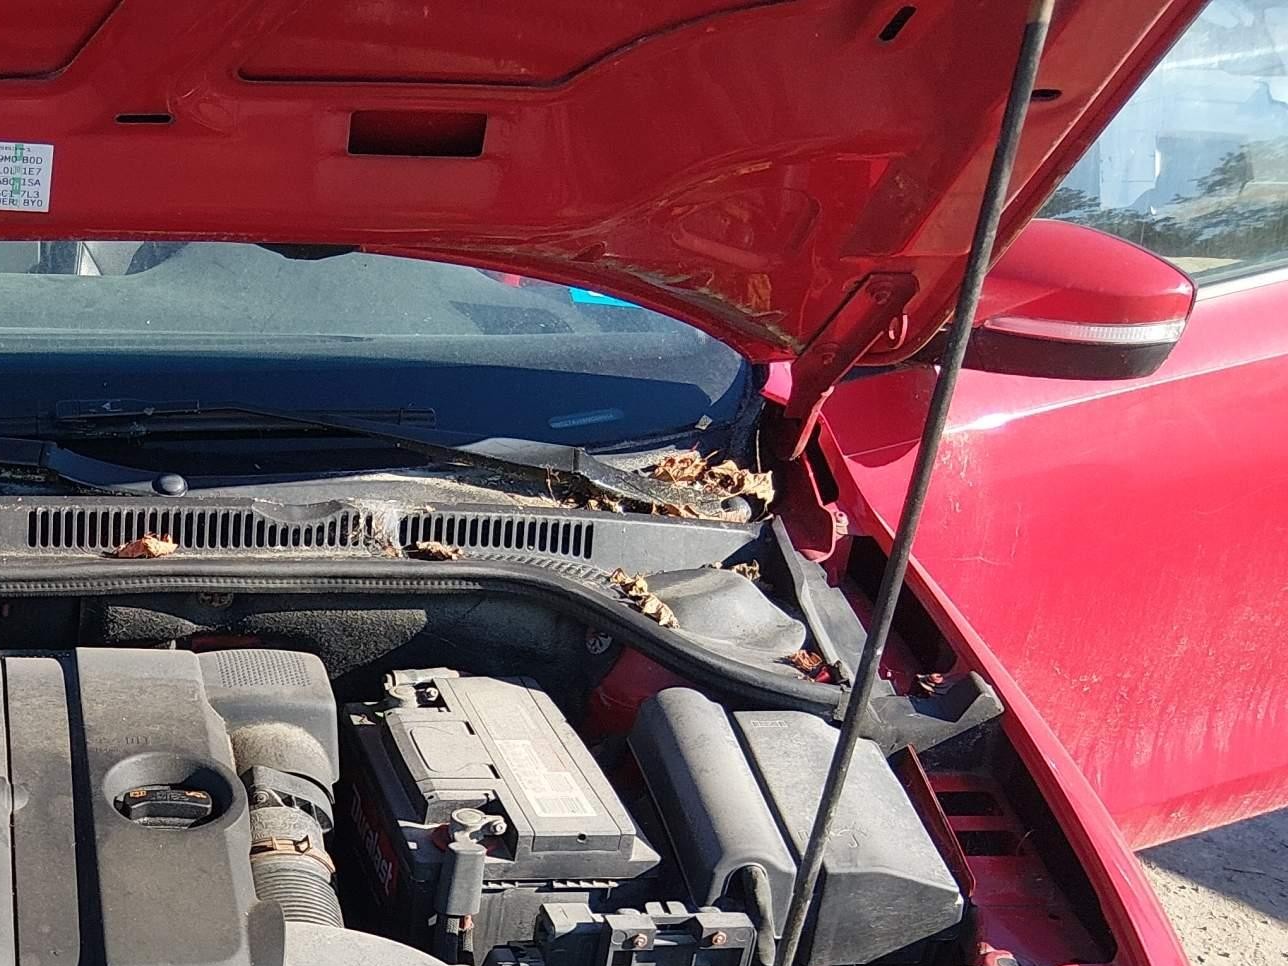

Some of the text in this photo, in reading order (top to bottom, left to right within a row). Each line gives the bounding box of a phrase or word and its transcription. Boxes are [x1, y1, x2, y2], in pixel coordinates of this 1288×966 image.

[22, 168, 42, 176] 1E7
[22, 178, 40, 186] 1SA
[21, 190, 40, 198] 7L3
